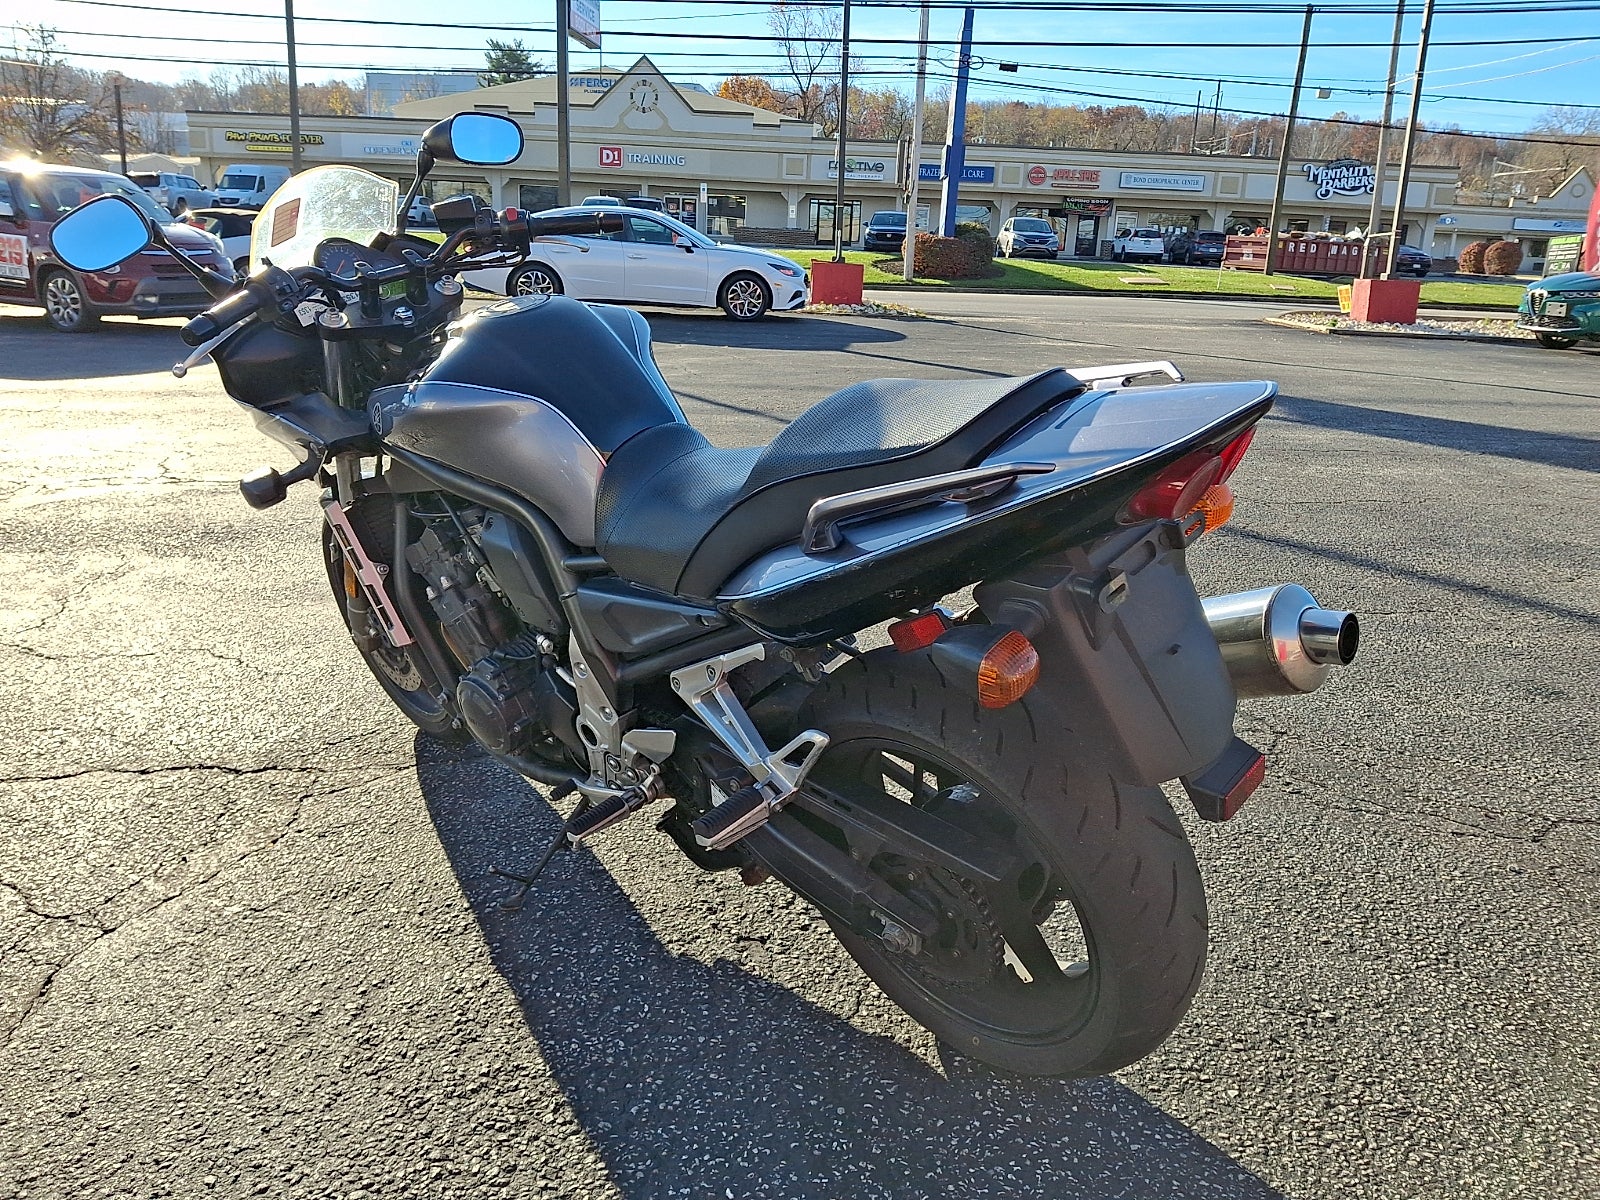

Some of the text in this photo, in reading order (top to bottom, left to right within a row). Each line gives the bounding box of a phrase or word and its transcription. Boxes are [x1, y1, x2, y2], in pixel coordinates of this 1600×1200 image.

[226, 131, 323, 144] PAW PRINTS FOEVER
[602, 149, 685, 166] D1 TRAINING
[968, 170, 985, 178] CARE
[1303, 163, 1375, 184] MENTALITY
[1316, 175, 1376, 200] BARBERS
[1288, 241, 1317, 253] RED
